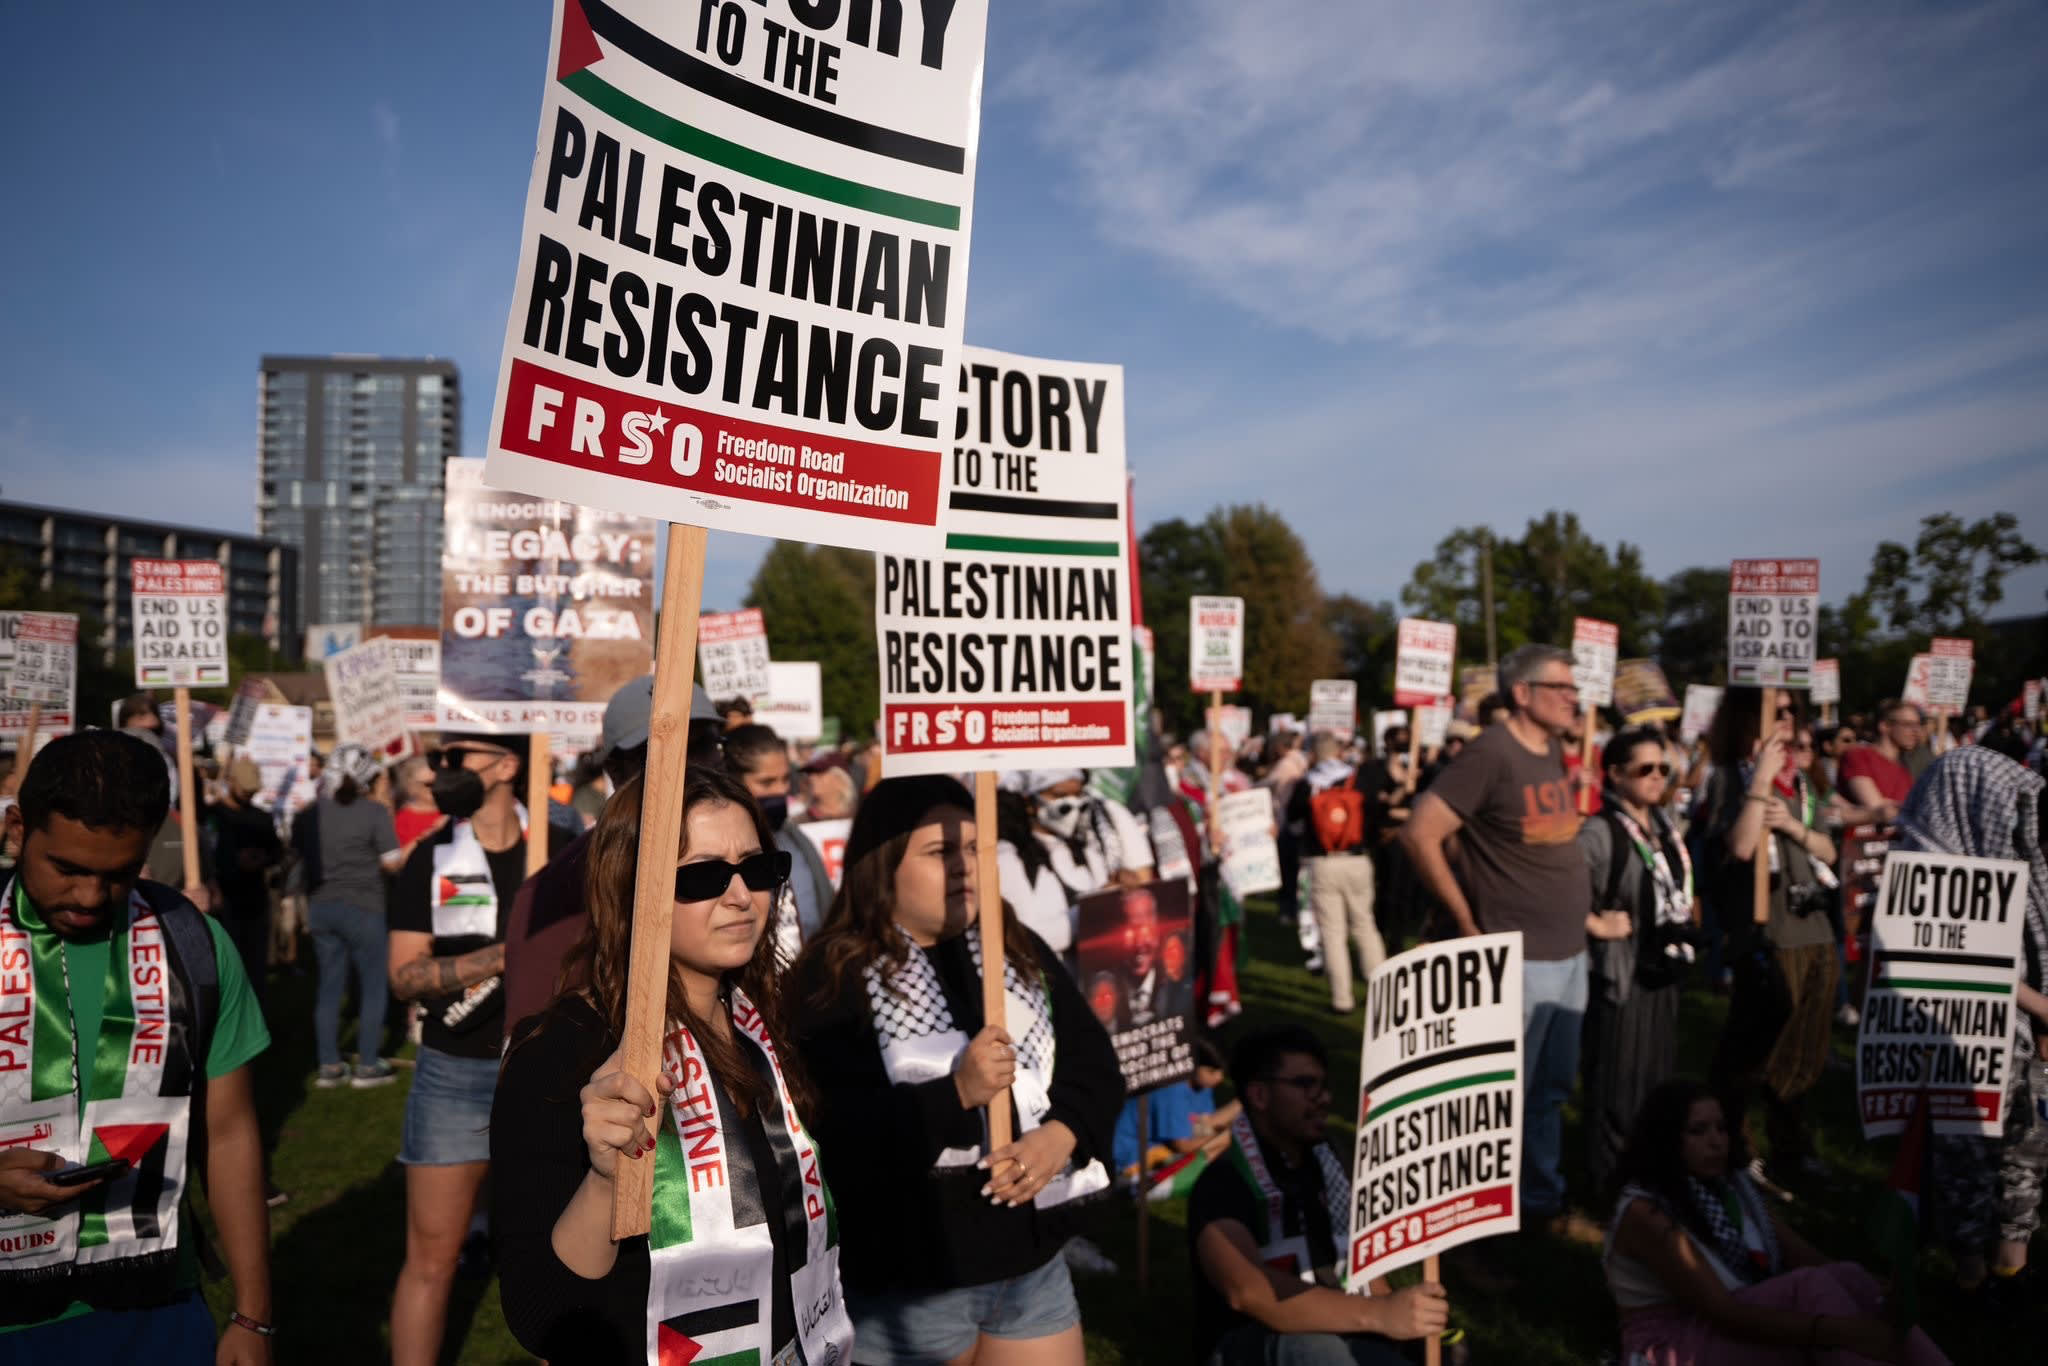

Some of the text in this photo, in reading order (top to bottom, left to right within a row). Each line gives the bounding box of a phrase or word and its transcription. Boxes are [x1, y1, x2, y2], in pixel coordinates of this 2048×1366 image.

[696, 0, 841, 106] TO THE
[543, 105, 951, 329] PALESTINIAN
[523, 233, 944, 440] RESISTANCE
[527, 383, 703, 477] FRSO
[716, 430, 844, 475] Freedom Road
[714, 458, 910, 512] Socialist Organization
[953, 448, 1039, 493] TO THE
[140, 598, 179, 615] END
[455, 574, 510, 594] THE
[884, 555, 1119, 621] PALESTINIAN
[1735, 598, 1773, 615] END
[142, 619, 220, 638] AID TO
[453, 606, 642, 641] OF GAZA
[1735, 619, 1812, 638] AID TO
[142, 641, 221, 659] ISRAEL!
[885, 630, 1122, 694] RESISTANCE
[893, 710, 986, 747] FRSO
[1885, 861, 2019, 923] VICTORY
[1913, 920, 1966, 950] TO THE
[132, 902, 165, 1064] ALESTINE
[1371, 945, 1510, 1042] VICTORY
[1399, 1017, 1456, 1059] TO THE
[1864, 995, 2008, 1039] PALESTINIAN
[1861, 1041, 2005, 1086] RESISTANCE
[664, 1027, 725, 1193] ESTINE
[1357, 1089, 1514, 1180] PALESTINIAN
[1355, 1138, 1512, 1234] RESISTANCE
